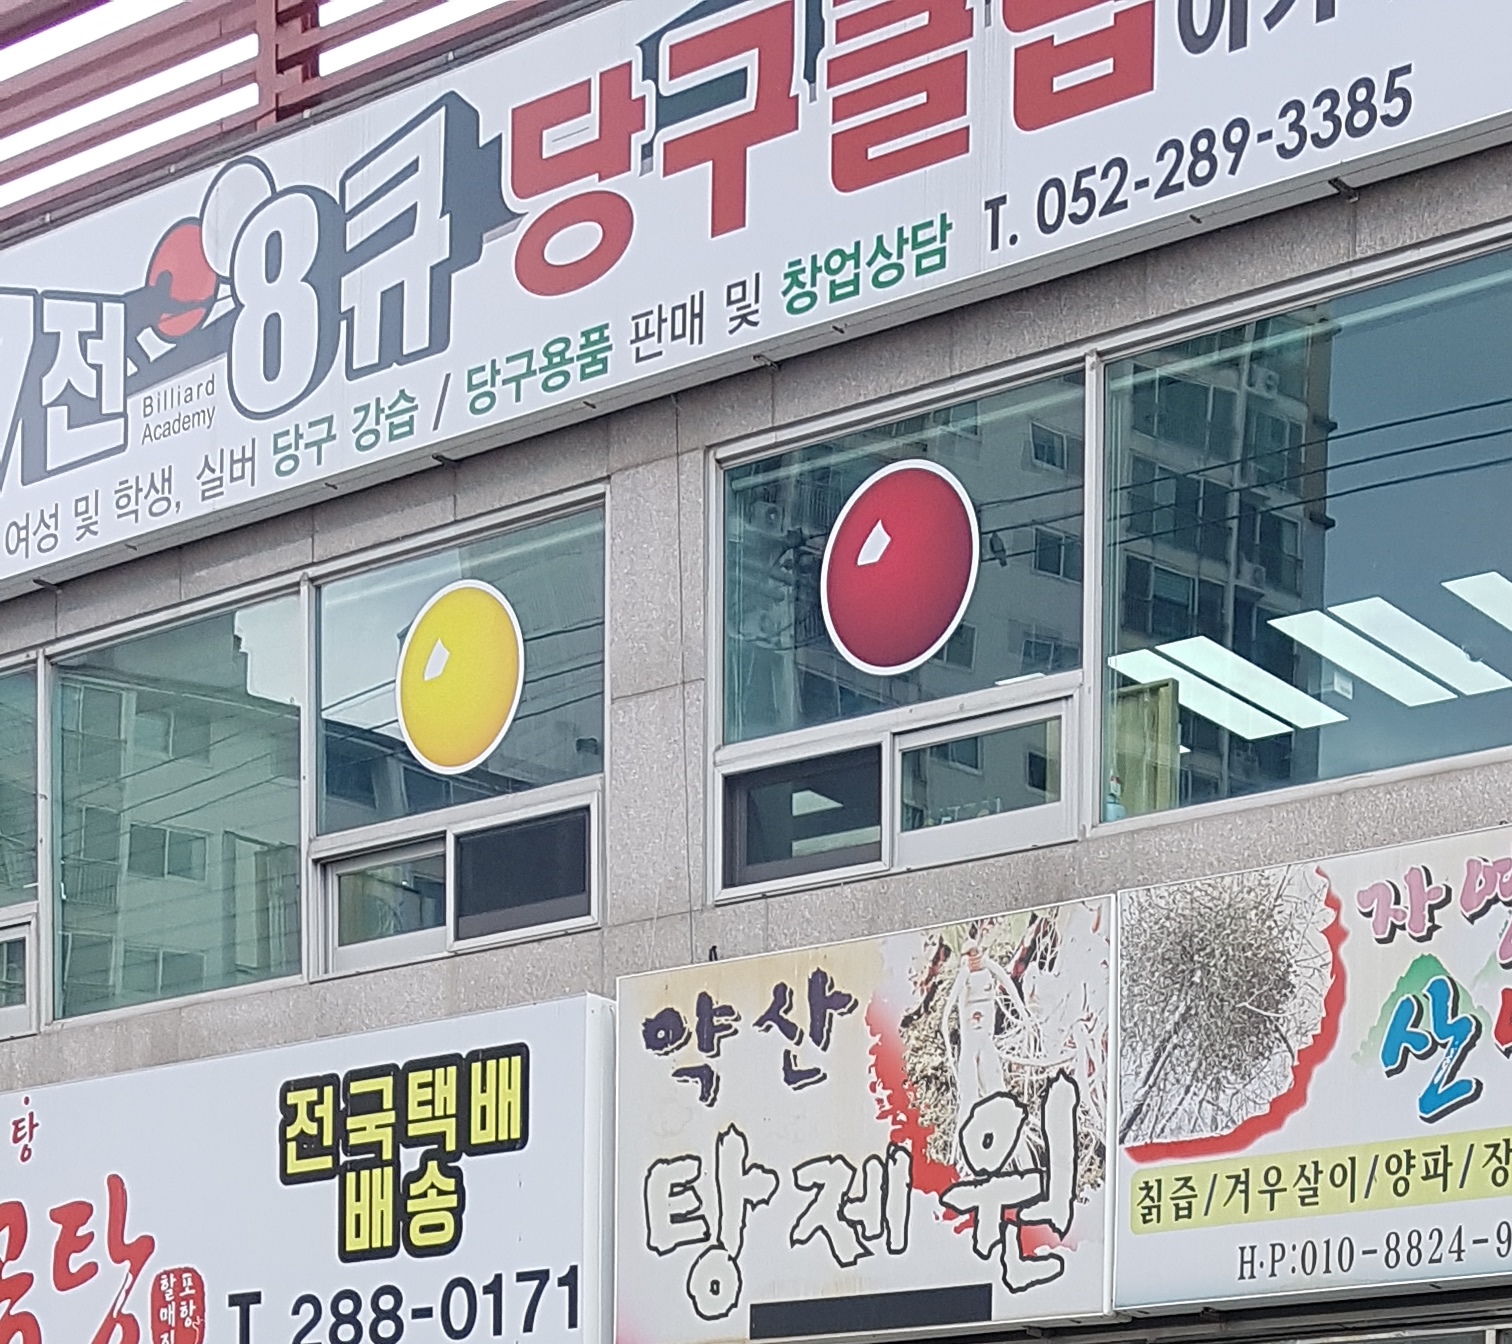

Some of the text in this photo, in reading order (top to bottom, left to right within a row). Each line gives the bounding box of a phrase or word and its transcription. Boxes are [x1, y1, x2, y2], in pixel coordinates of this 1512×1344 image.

[5, 504, 59, 561] 여성
[74, 490, 99, 542] 및
[114, 465, 181, 524] 학생,
[197, 438, 256, 503] 실버
[273, 415, 337, 477] 당구
[352, 388, 419, 452] 강습
[465, 321, 613, 416] 당구용품
[629, 290, 704, 364] 판매
[725, 271, 761, 336] 및
[781, 212, 953, 316] 창업상담
[984, 194, 1019, 252] T.
[1036, 63, 1414, 238] 052-289-3385
[228, 92, 486, 419] 8큐
[141, 405, 216, 445] Academy
[142, 373, 215, 418] Billiard
[642, 967, 859, 1108] 약산
[281, 1044, 528, 1183] 전국택배
[339, 1152, 463, 1261] 배송
[643, 1068, 1081, 1321] 탕제원
[180, 1272, 196, 1328] 포항
